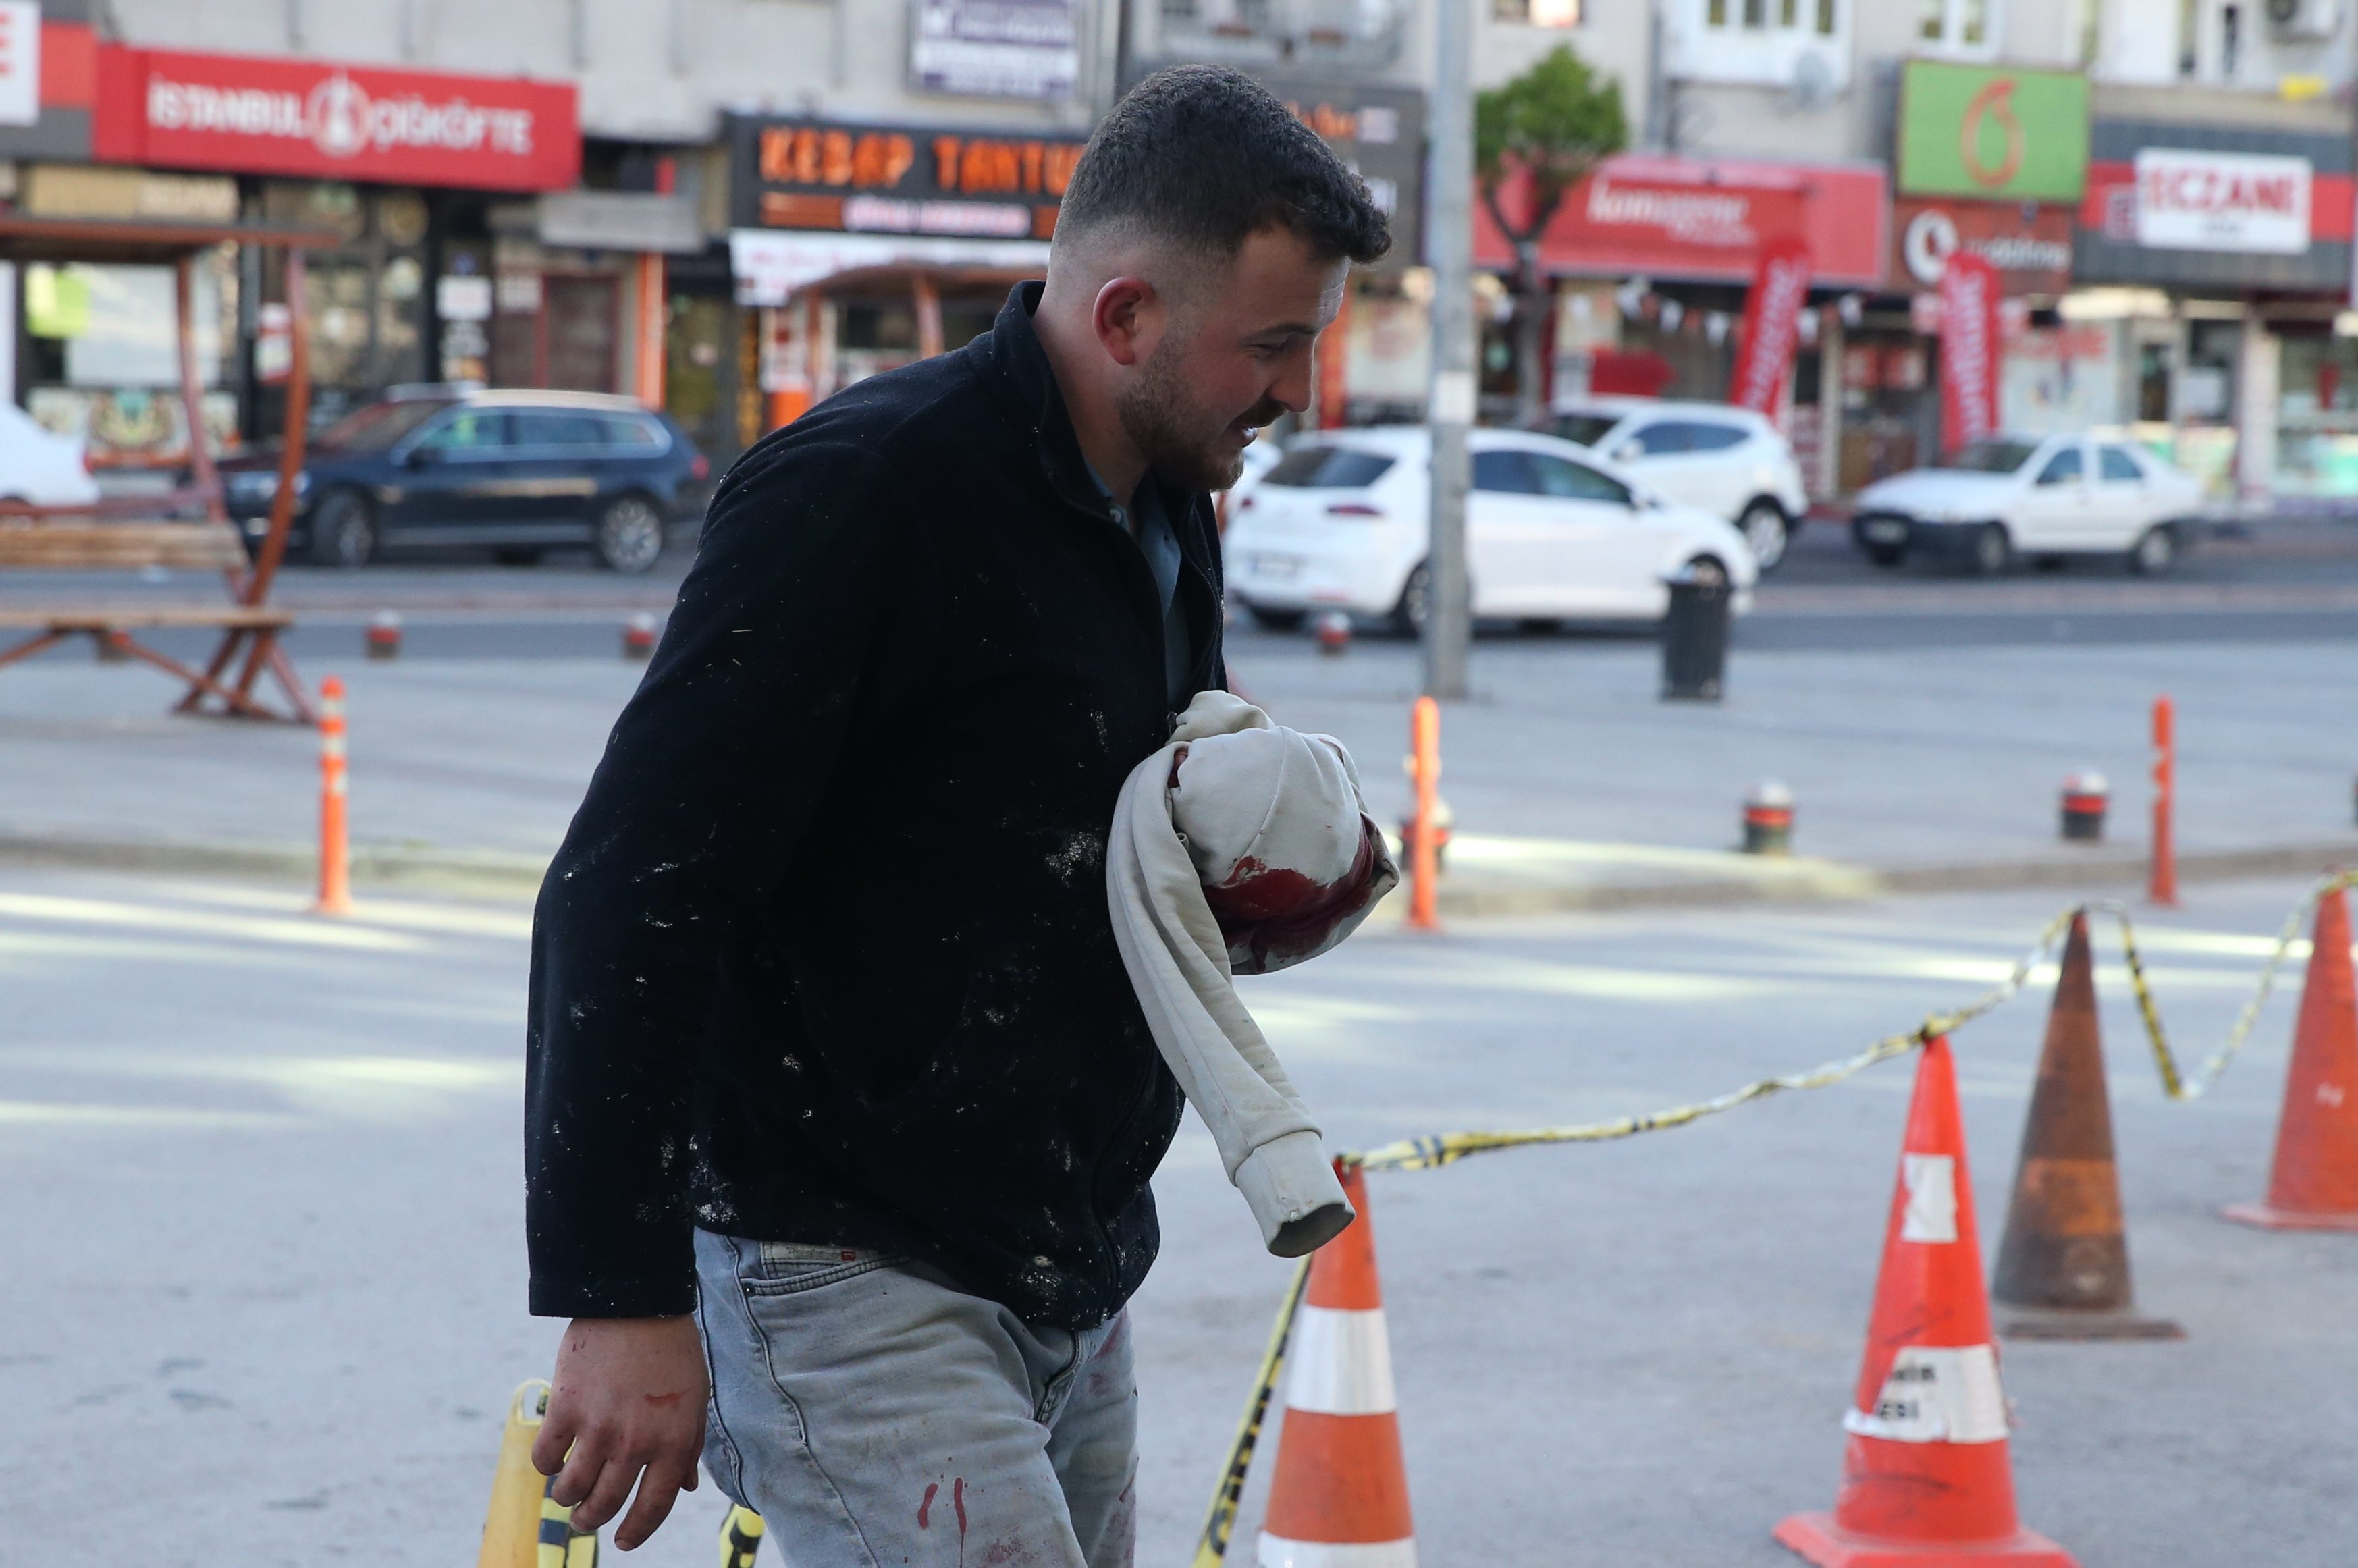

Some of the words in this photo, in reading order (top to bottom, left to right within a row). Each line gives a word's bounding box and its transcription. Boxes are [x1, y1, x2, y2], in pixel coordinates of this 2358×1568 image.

[147, 72, 309, 138] İSTANBUL
[759, 126, 914, 190] KEBAP
[933, 136, 1086, 197] TANTU
